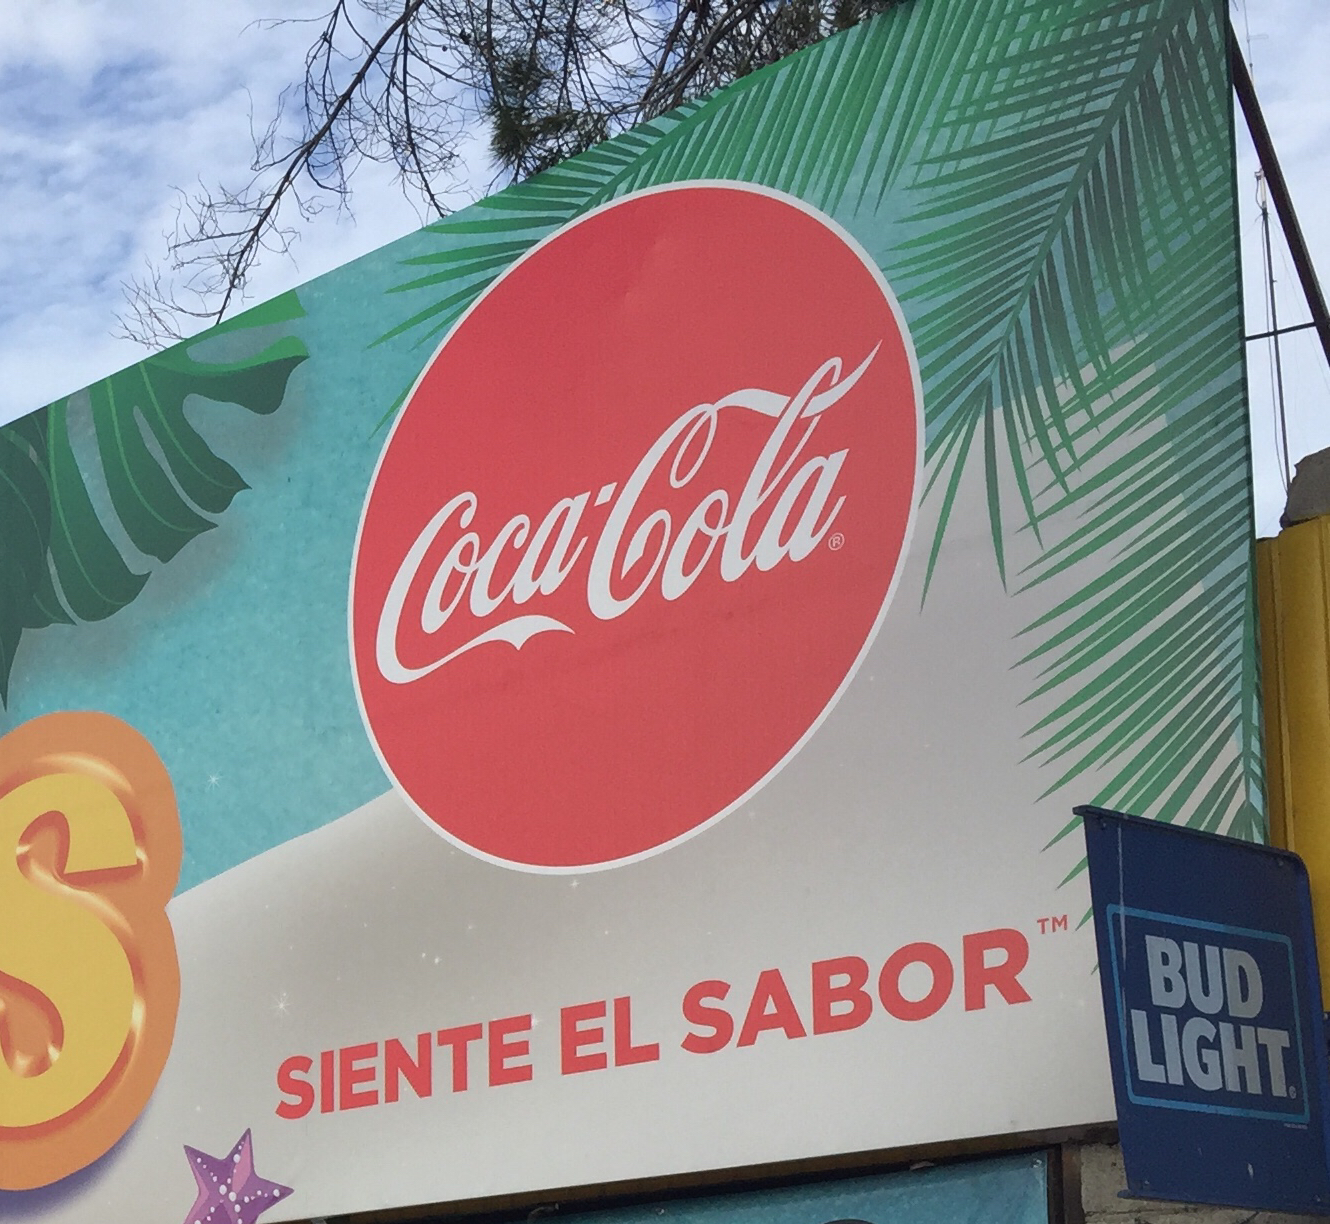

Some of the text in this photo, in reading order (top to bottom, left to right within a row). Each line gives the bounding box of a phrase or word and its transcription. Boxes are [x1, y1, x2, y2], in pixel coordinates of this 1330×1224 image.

[375, 340, 883, 685] Coca-Cola
[1144, 934, 1263, 1019] BUD
[274, 1014, 534, 1120] SIENTE
[559, 996, 660, 1075] EL
[1130, 1009, 1290, 1098] LIGHT
